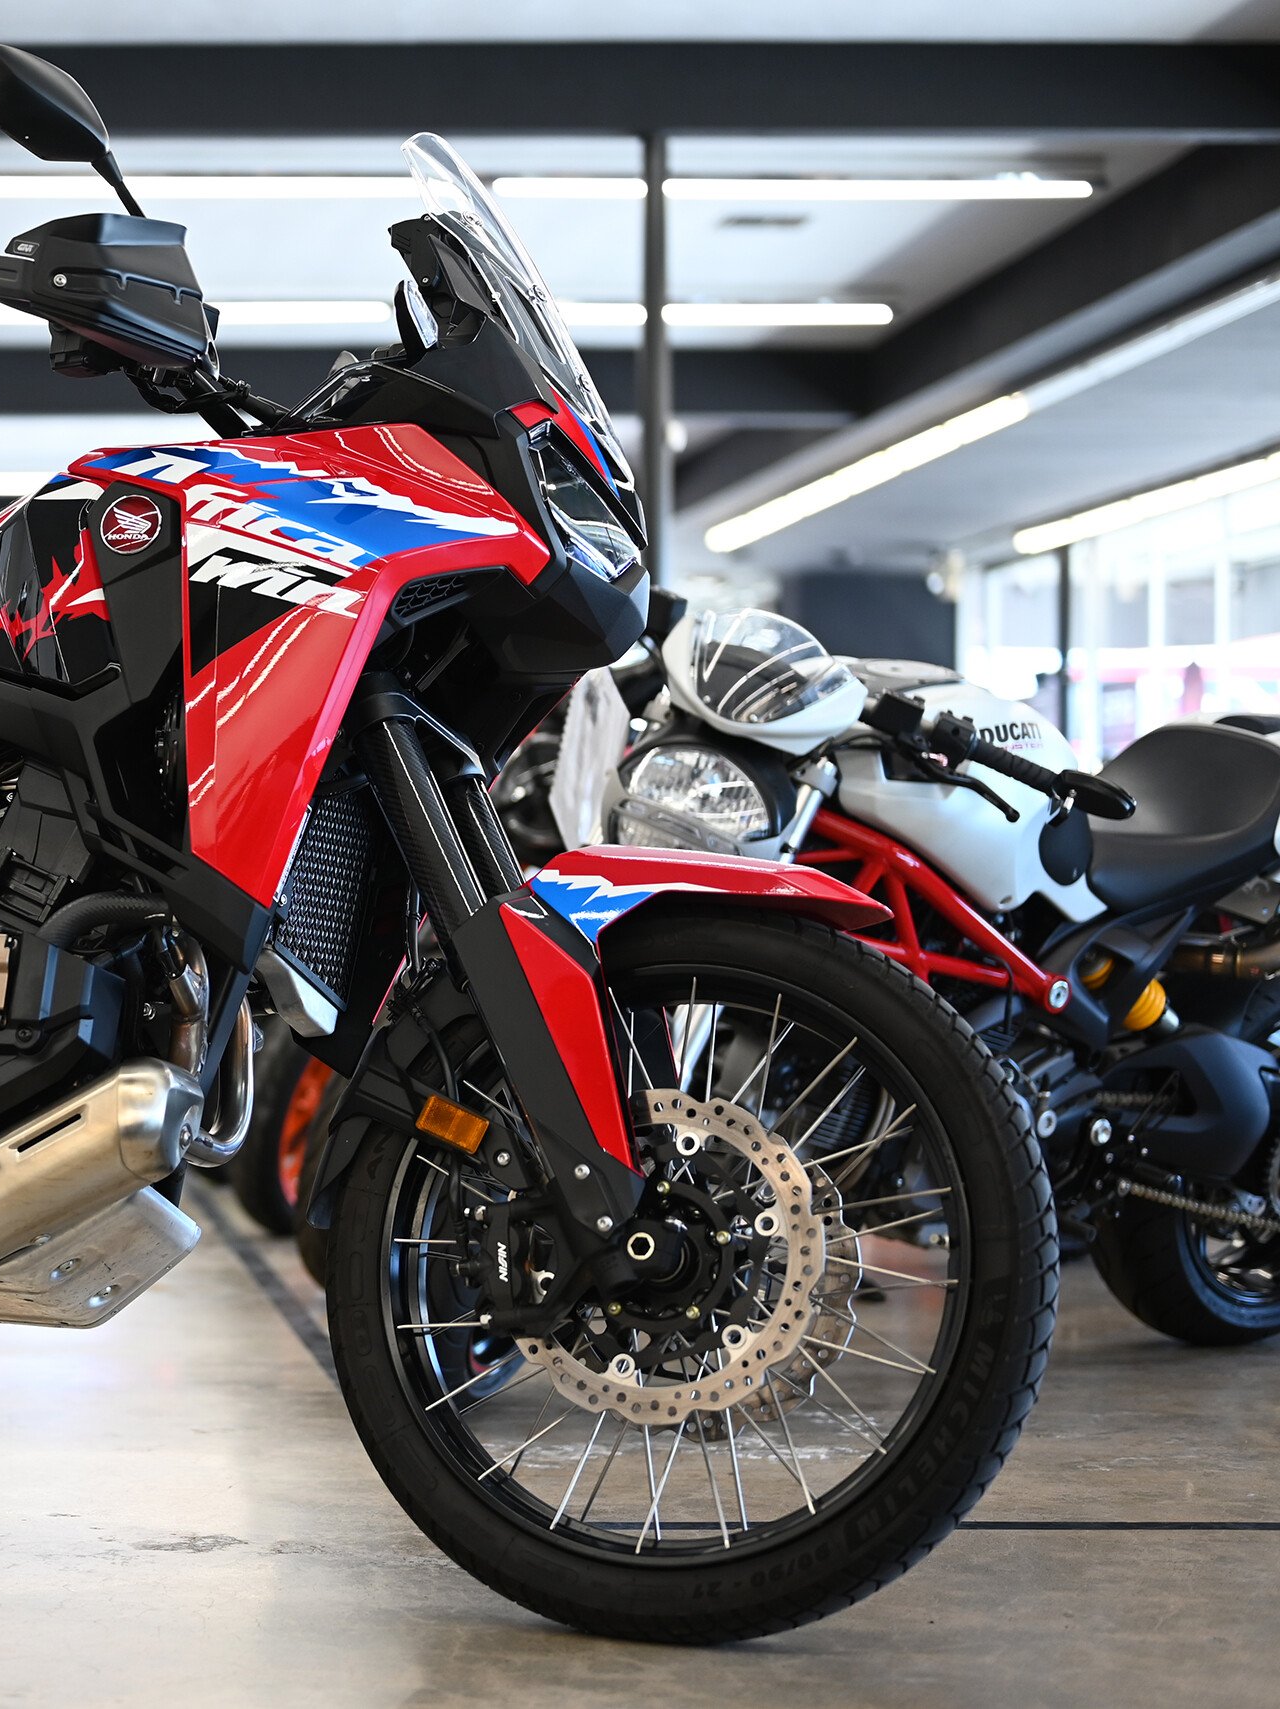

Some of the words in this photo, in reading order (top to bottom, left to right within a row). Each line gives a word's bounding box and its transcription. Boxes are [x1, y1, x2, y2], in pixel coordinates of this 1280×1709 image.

[107, 533, 151, 541] HONDA
[979, 722, 1042, 744] DUCATI
[856, 1340, 997, 1542] MICHELIN
